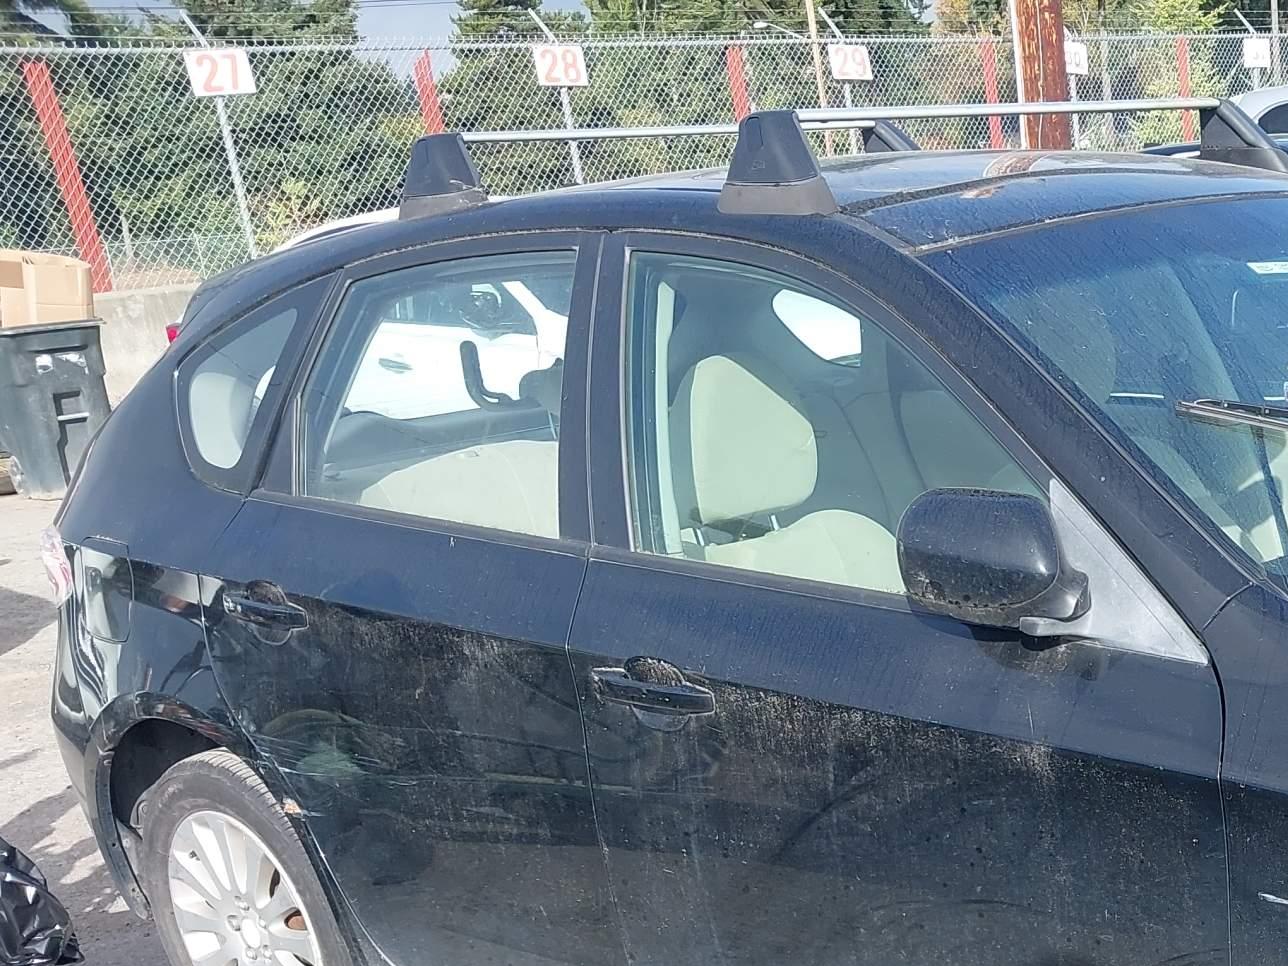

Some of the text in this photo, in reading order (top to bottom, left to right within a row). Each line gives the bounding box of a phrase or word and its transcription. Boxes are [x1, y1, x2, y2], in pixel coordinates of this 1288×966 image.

[196, 54, 238, 92] 27
[540, 48, 581, 83] 28
[834, 48, 867, 77] 29
